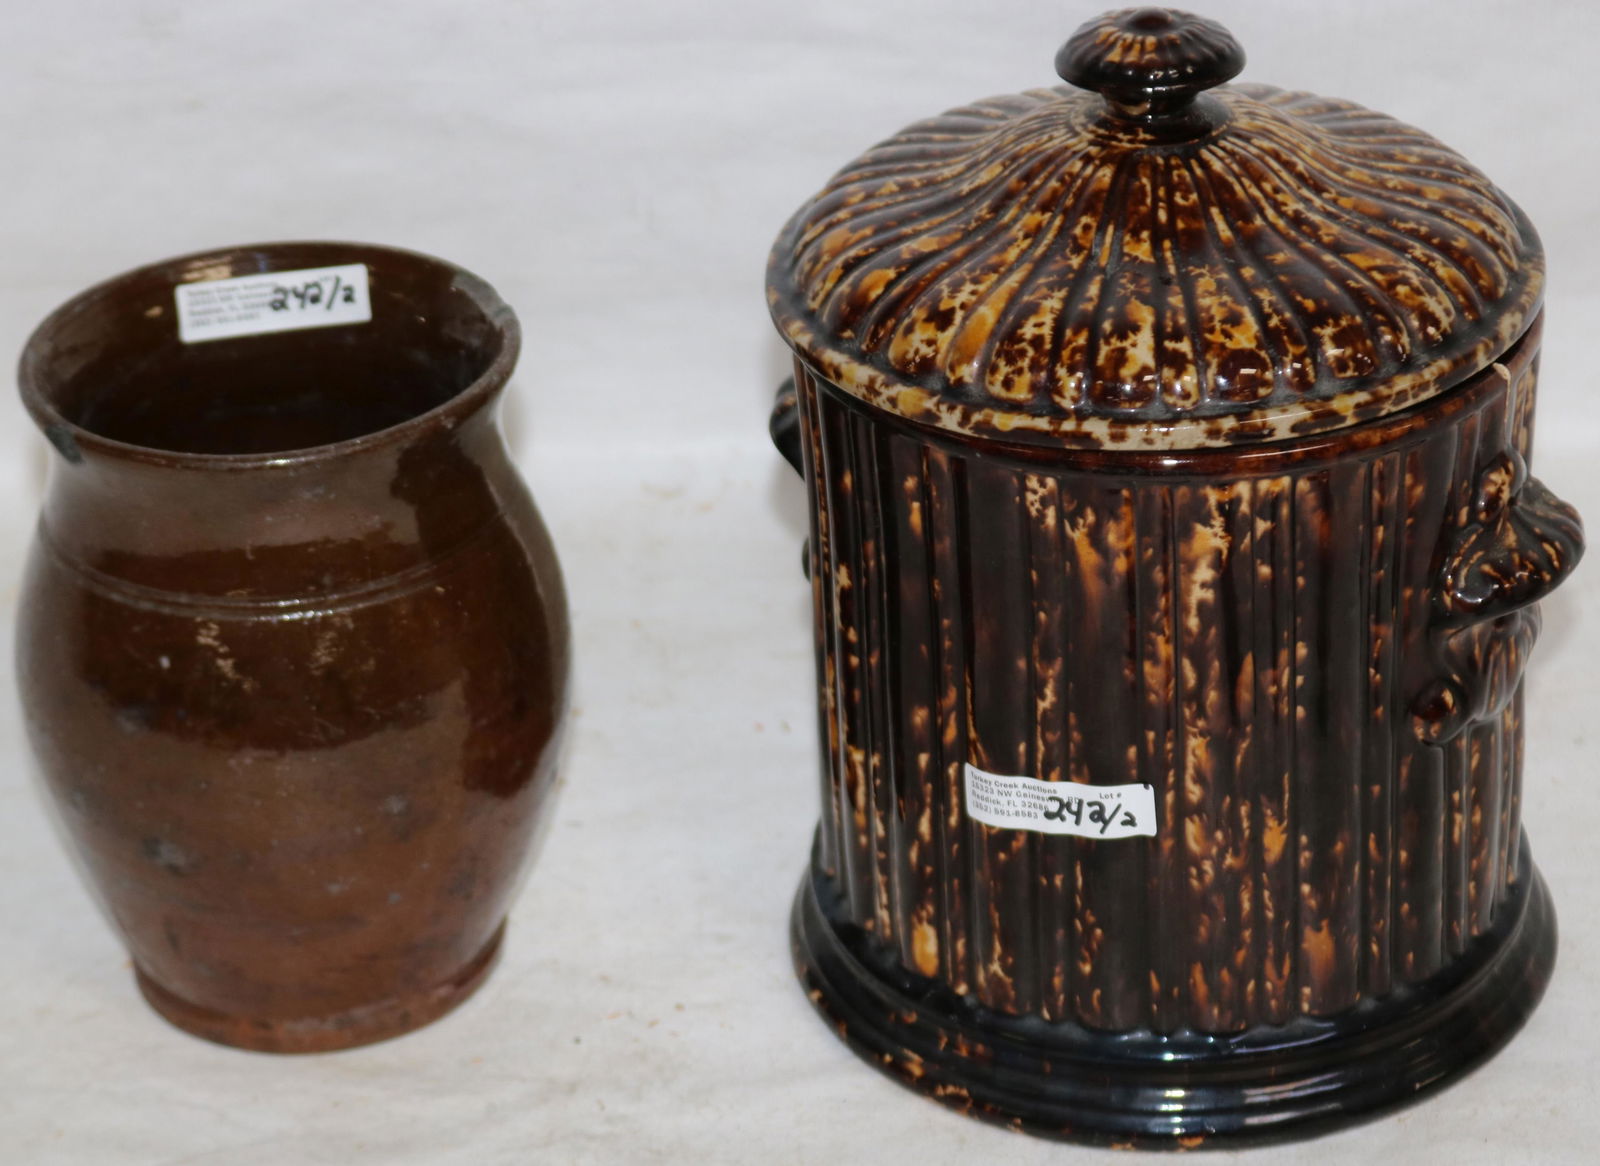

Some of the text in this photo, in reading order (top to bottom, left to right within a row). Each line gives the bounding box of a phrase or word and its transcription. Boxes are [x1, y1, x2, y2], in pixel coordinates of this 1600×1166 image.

[970, 771, 1058, 795] Turkey Creek Auctions
[997, 790, 1013, 798] NW
[1099, 792, 1114, 800] Lot
